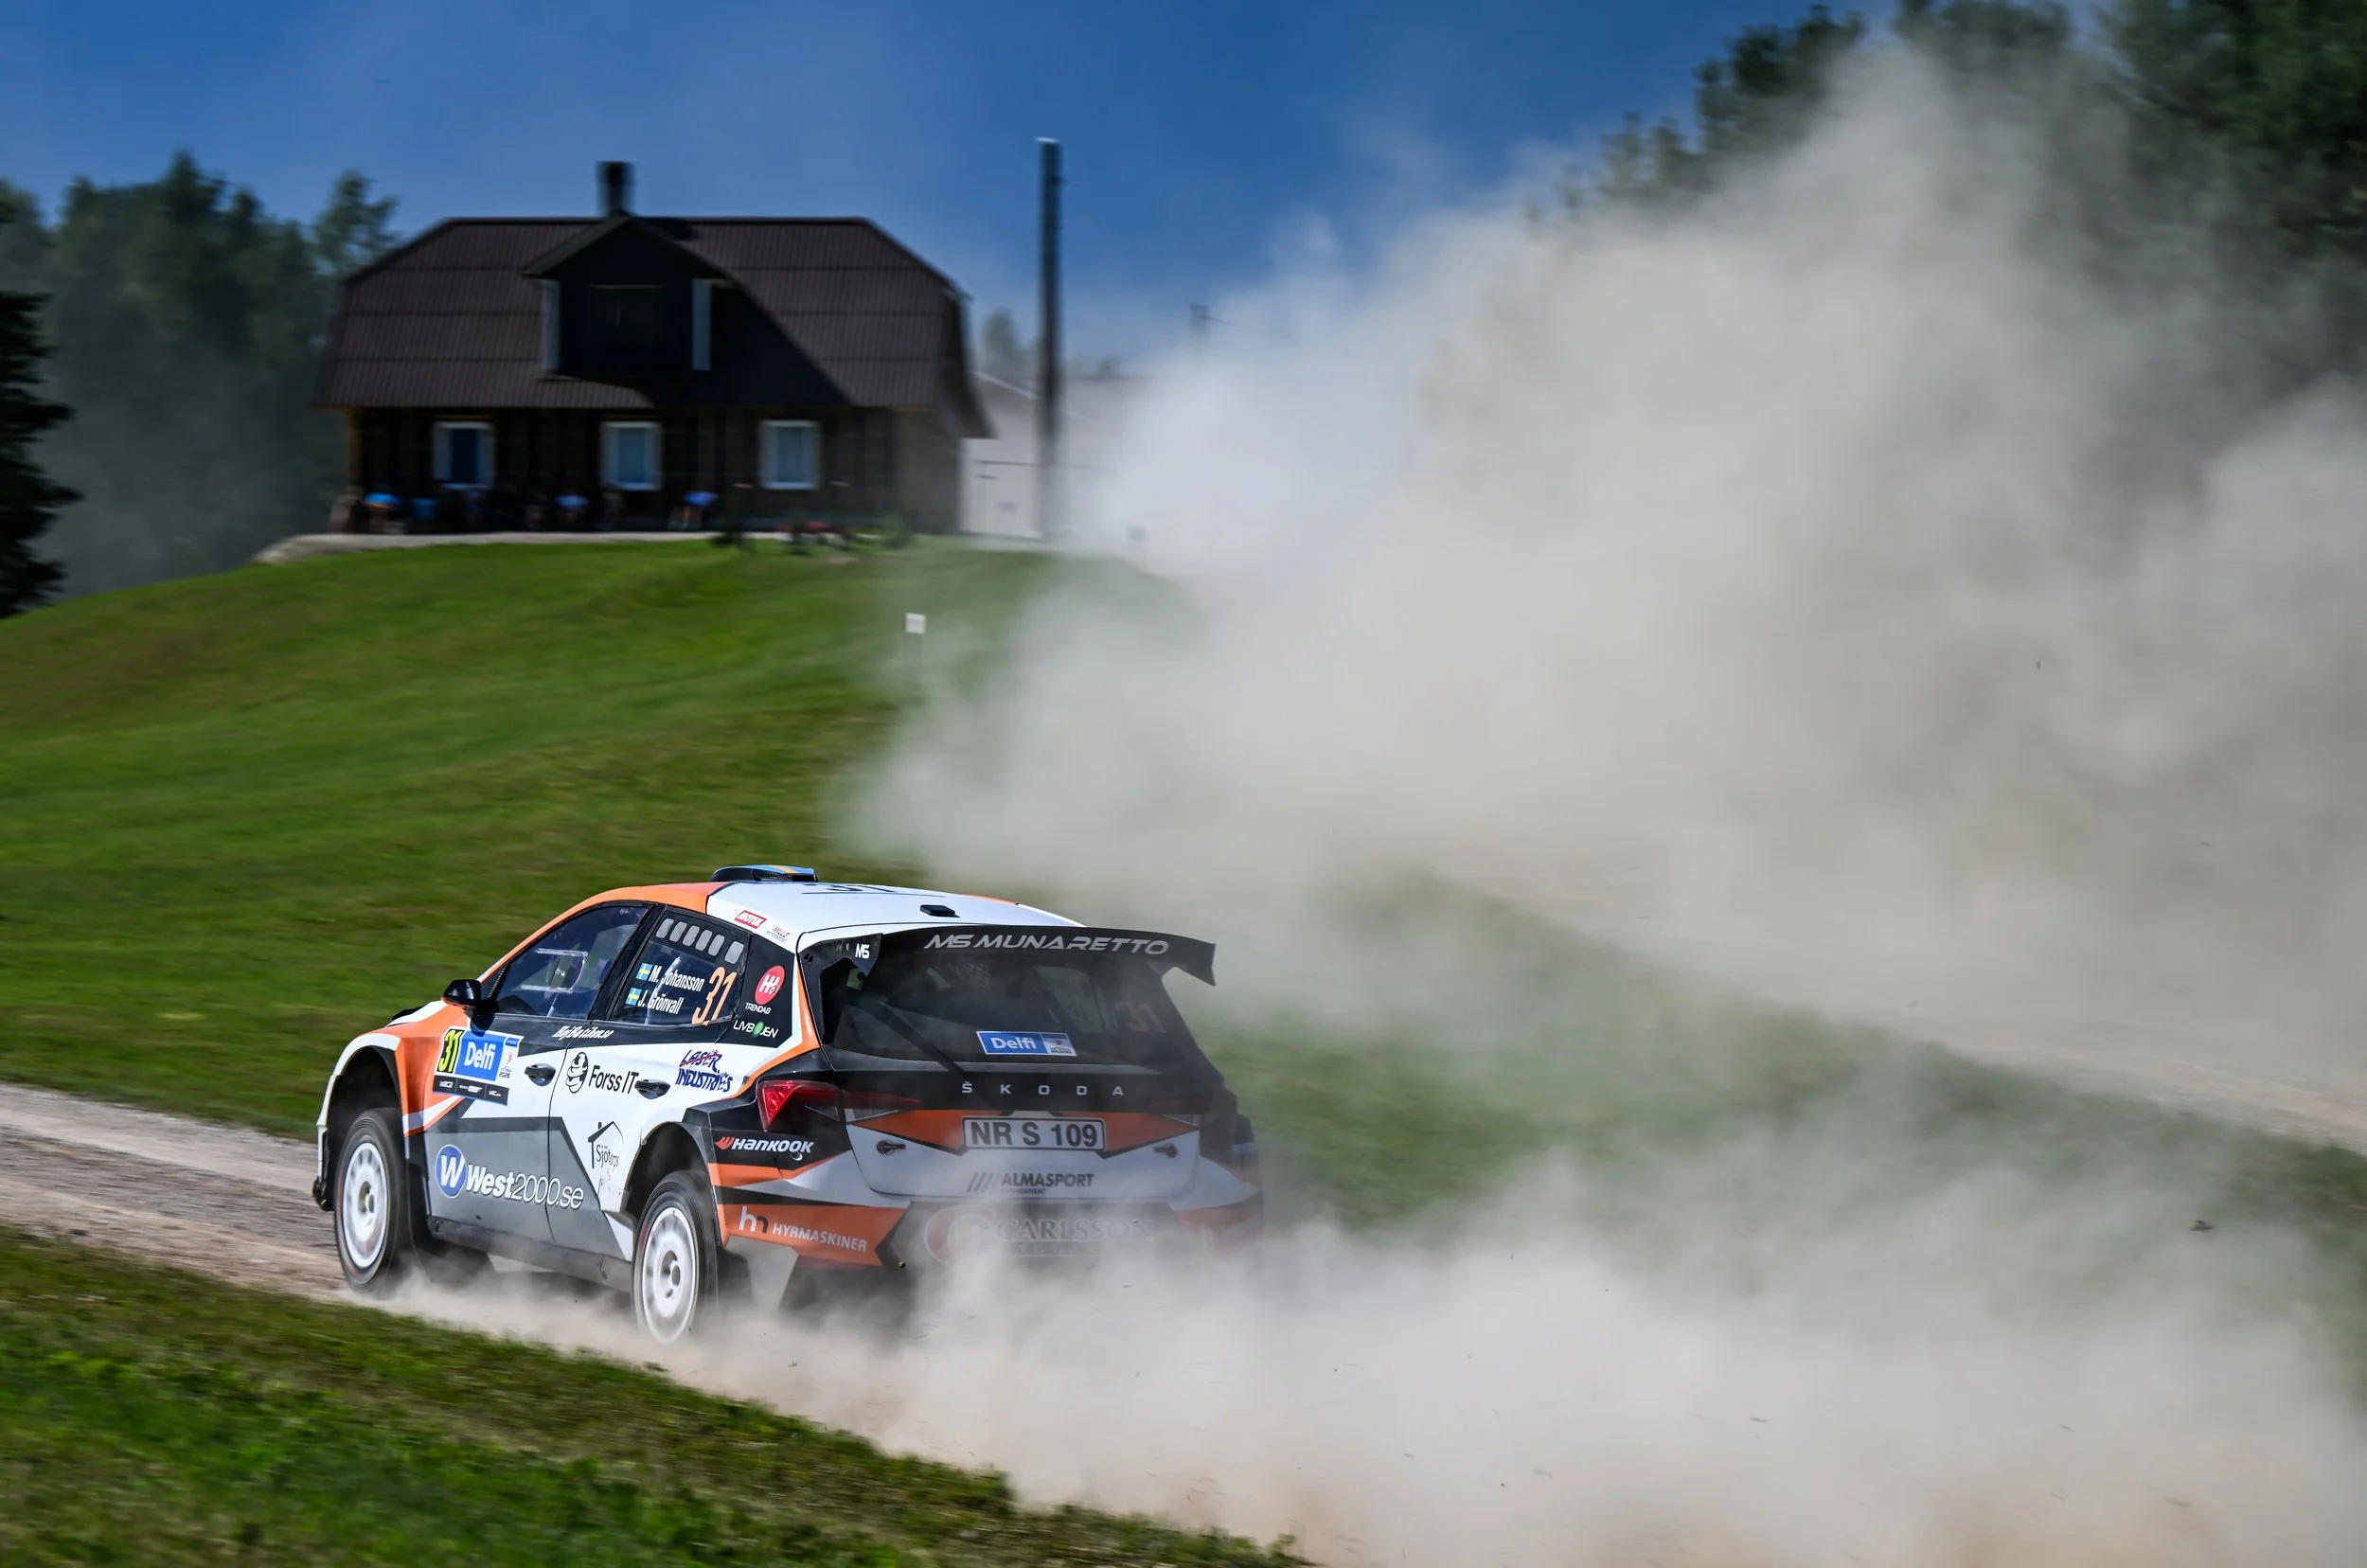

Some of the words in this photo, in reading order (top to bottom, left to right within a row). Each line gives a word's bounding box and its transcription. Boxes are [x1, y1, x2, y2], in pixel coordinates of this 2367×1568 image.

[924, 934, 974, 949] MS
[973, 934, 1169, 955] MUNARETTO
[649, 965, 663, 984] M.
[662, 969, 705, 992] Johansson
[637, 989, 649, 1007] J.
[648, 993, 685, 1015] Grönvall
[691, 966, 738, 1026] 31
[744, 1002, 772, 1015] TRENDAB
[438, 1029, 463, 1073] 31
[463, 1041, 497, 1071] Delfi
[989, 1036, 1038, 1049] Delfi
[588, 1064, 623, 1091] Forss
[621, 1070, 639, 1094] IT
[970, 1121, 1013, 1146] NR
[1022, 1121, 1041, 1147] S
[1050, 1123, 1098, 1148] 109
[439, 1154, 466, 1188] W
[465, 1163, 584, 1210] West2000.se
[1001, 1172, 1095, 1187] ALMASPORT
[772, 1222, 868, 1253] HYRMASKINER
[995, 1217, 1154, 1241] CARLSSON
